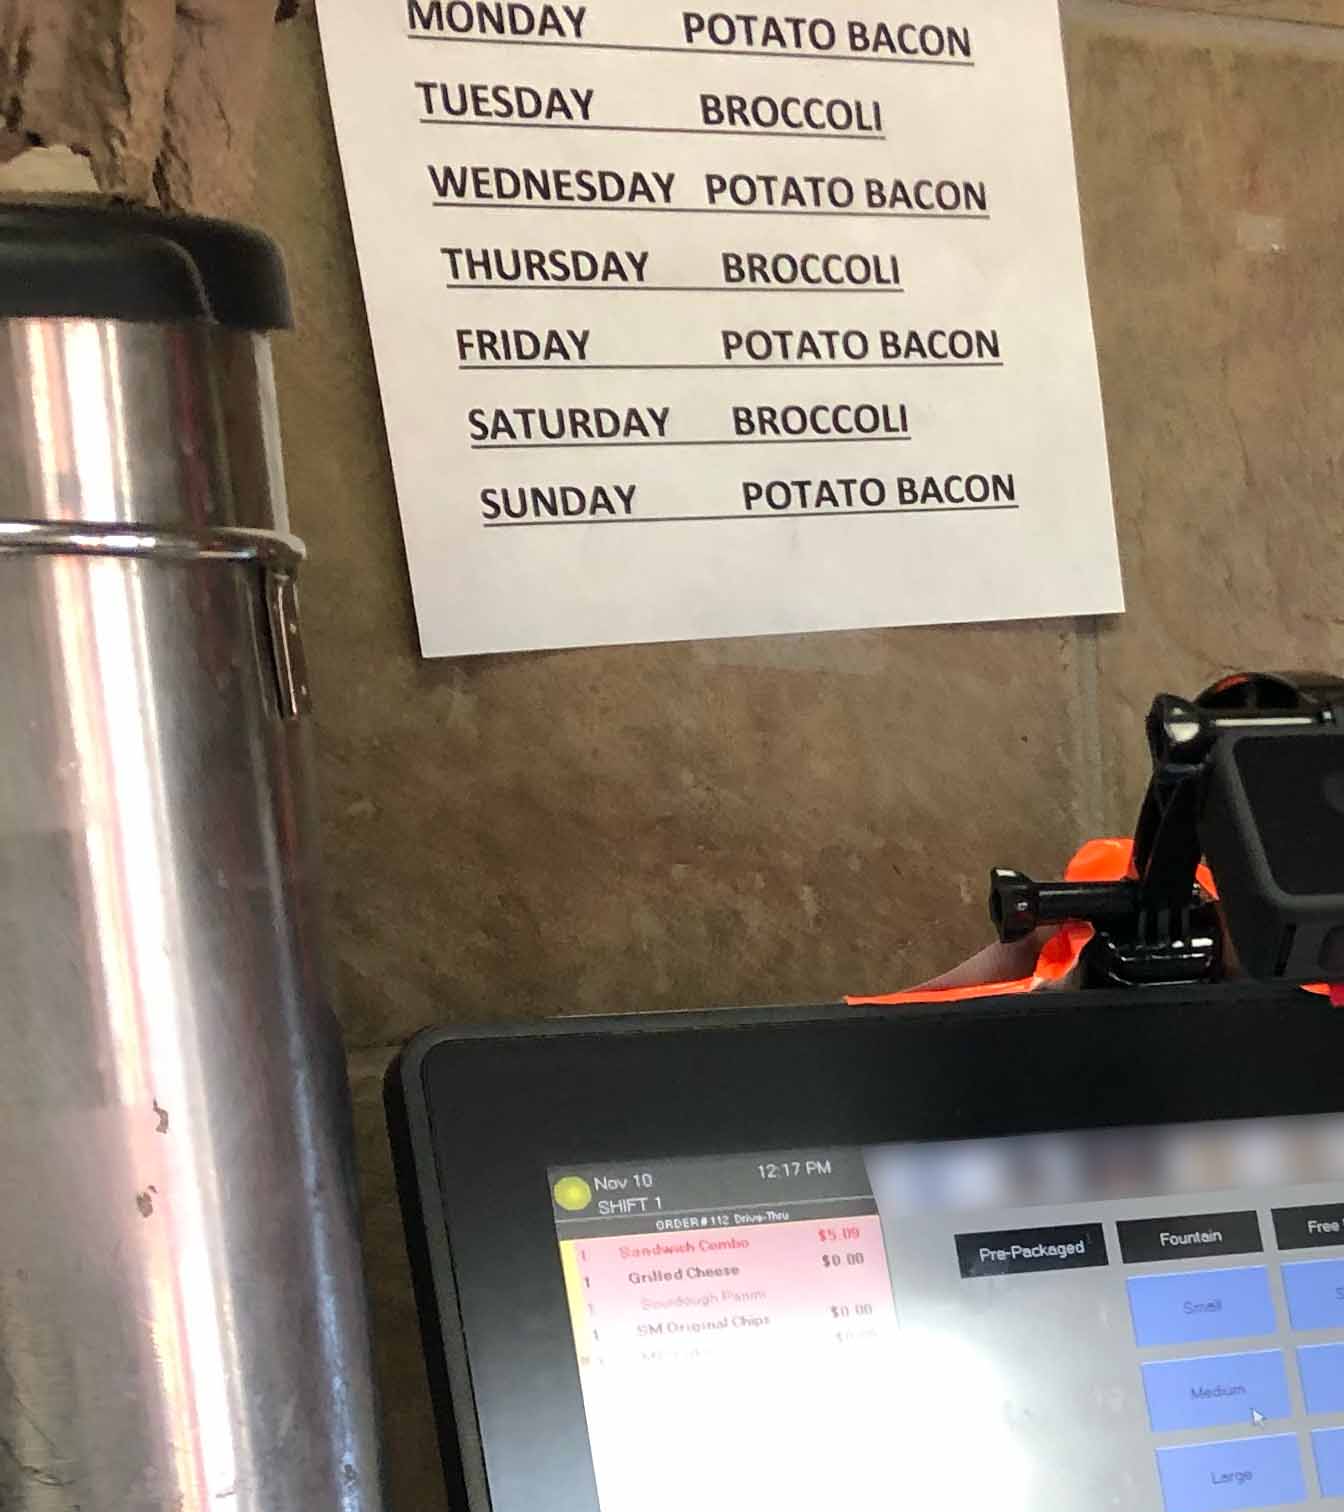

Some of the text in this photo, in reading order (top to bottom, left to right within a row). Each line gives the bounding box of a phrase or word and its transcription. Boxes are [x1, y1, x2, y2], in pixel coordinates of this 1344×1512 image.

[408, 0, 972, 57] MONDAY POTATO BACON
[415, 81, 883, 132] TUESDAY BROCCOLI
[427, 165, 987, 211] WEDNESDAY POTATO BACON
[441, 247, 901, 286] THURSDAY BROCCOLI
[457, 328, 1001, 361] FRIDAY POTATO BACON
[468, 404, 909, 441] SATURDAY BROCCOLI
[481, 473, 1016, 520] SUNDAY POTATO BACON
[594, 1160, 832, 1192] Nov 10 12:17 PM
[598, 1196, 663, 1215] SHIFT 1
[1159, 1226, 1222, 1249] Fountain
[1307, 1217, 1338, 1234] Free
[619, 1237, 750, 1259] Sandwich Combo
[979, 1239, 1085, 1264] Pre-Packaged
[628, 1267, 683, 1284] Grilled
[686, 1264, 740, 1280] Cheese
[667, 1316, 728, 1334] Original
[1190, 1381, 1247, 1401] Medium
[1211, 1466, 1253, 1488] Large
